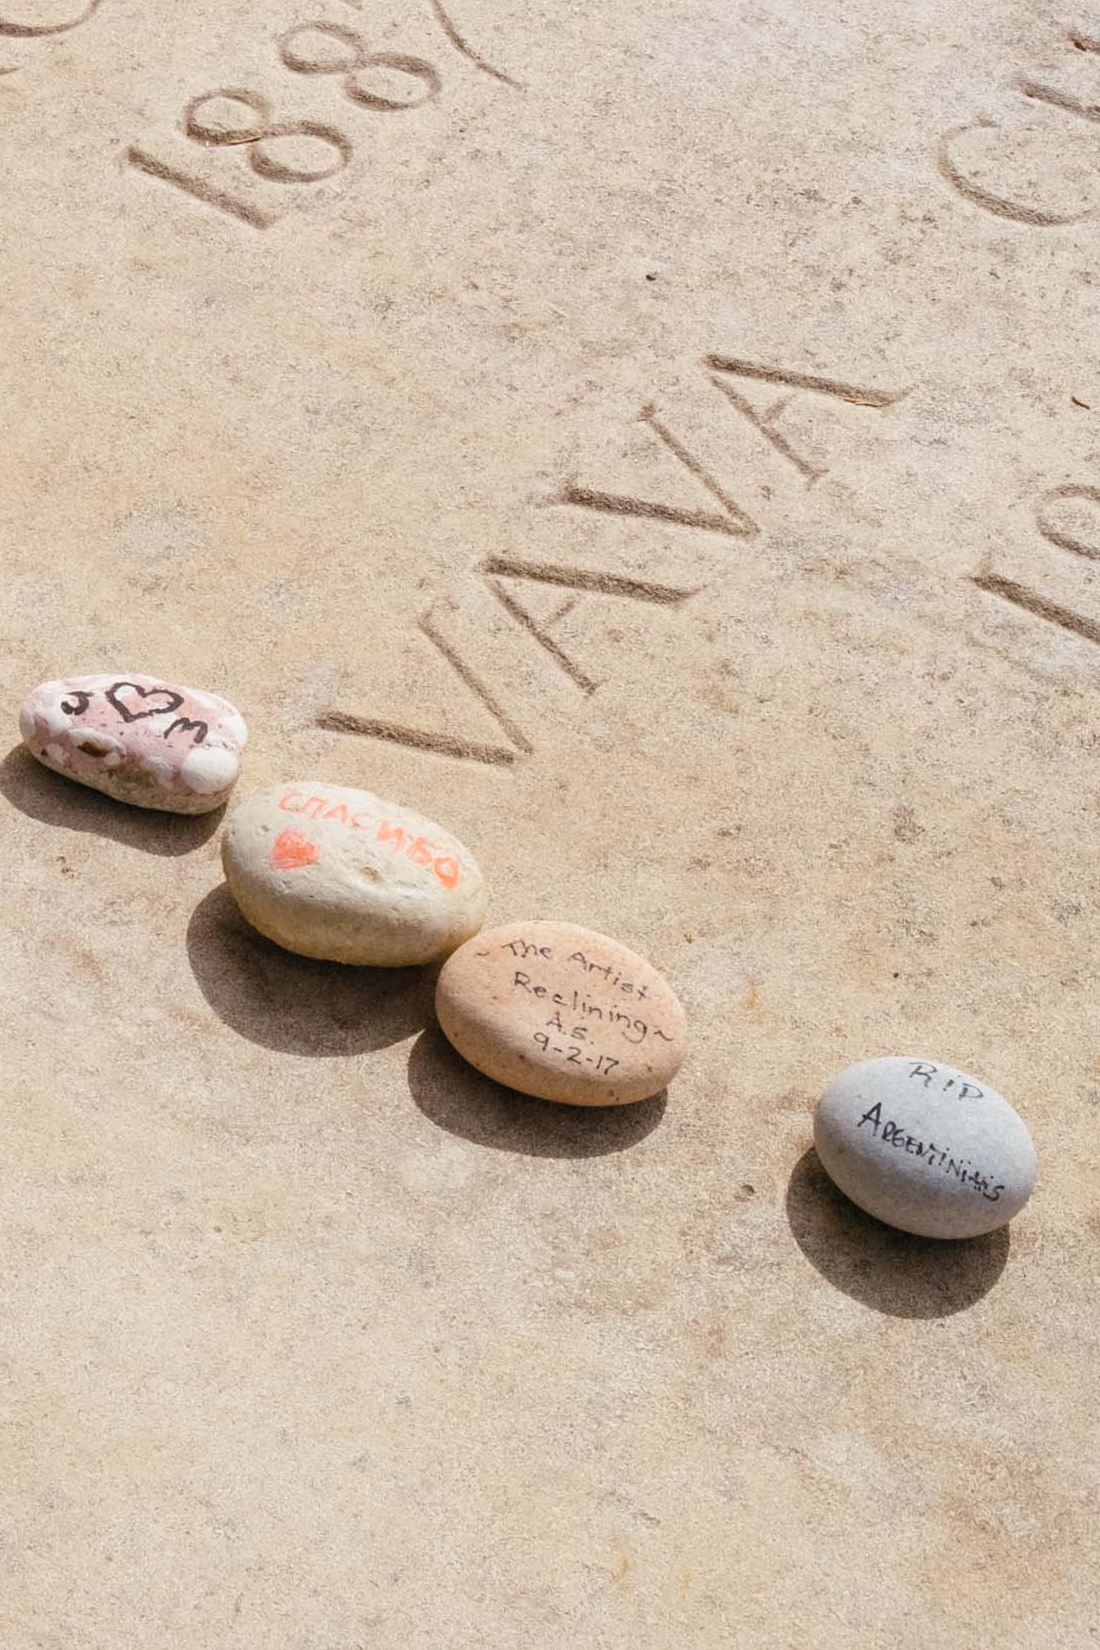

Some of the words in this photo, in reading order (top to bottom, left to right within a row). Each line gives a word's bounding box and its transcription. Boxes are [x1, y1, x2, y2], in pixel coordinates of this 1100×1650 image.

[312, 351, 912, 767] VAVA
[277, 788, 461, 891] СПАСИБО
[501, 937, 554, 962] The
[567, 950, 652, 1001] Artist
[532, 1031, 620, 1077] 9-2-17
